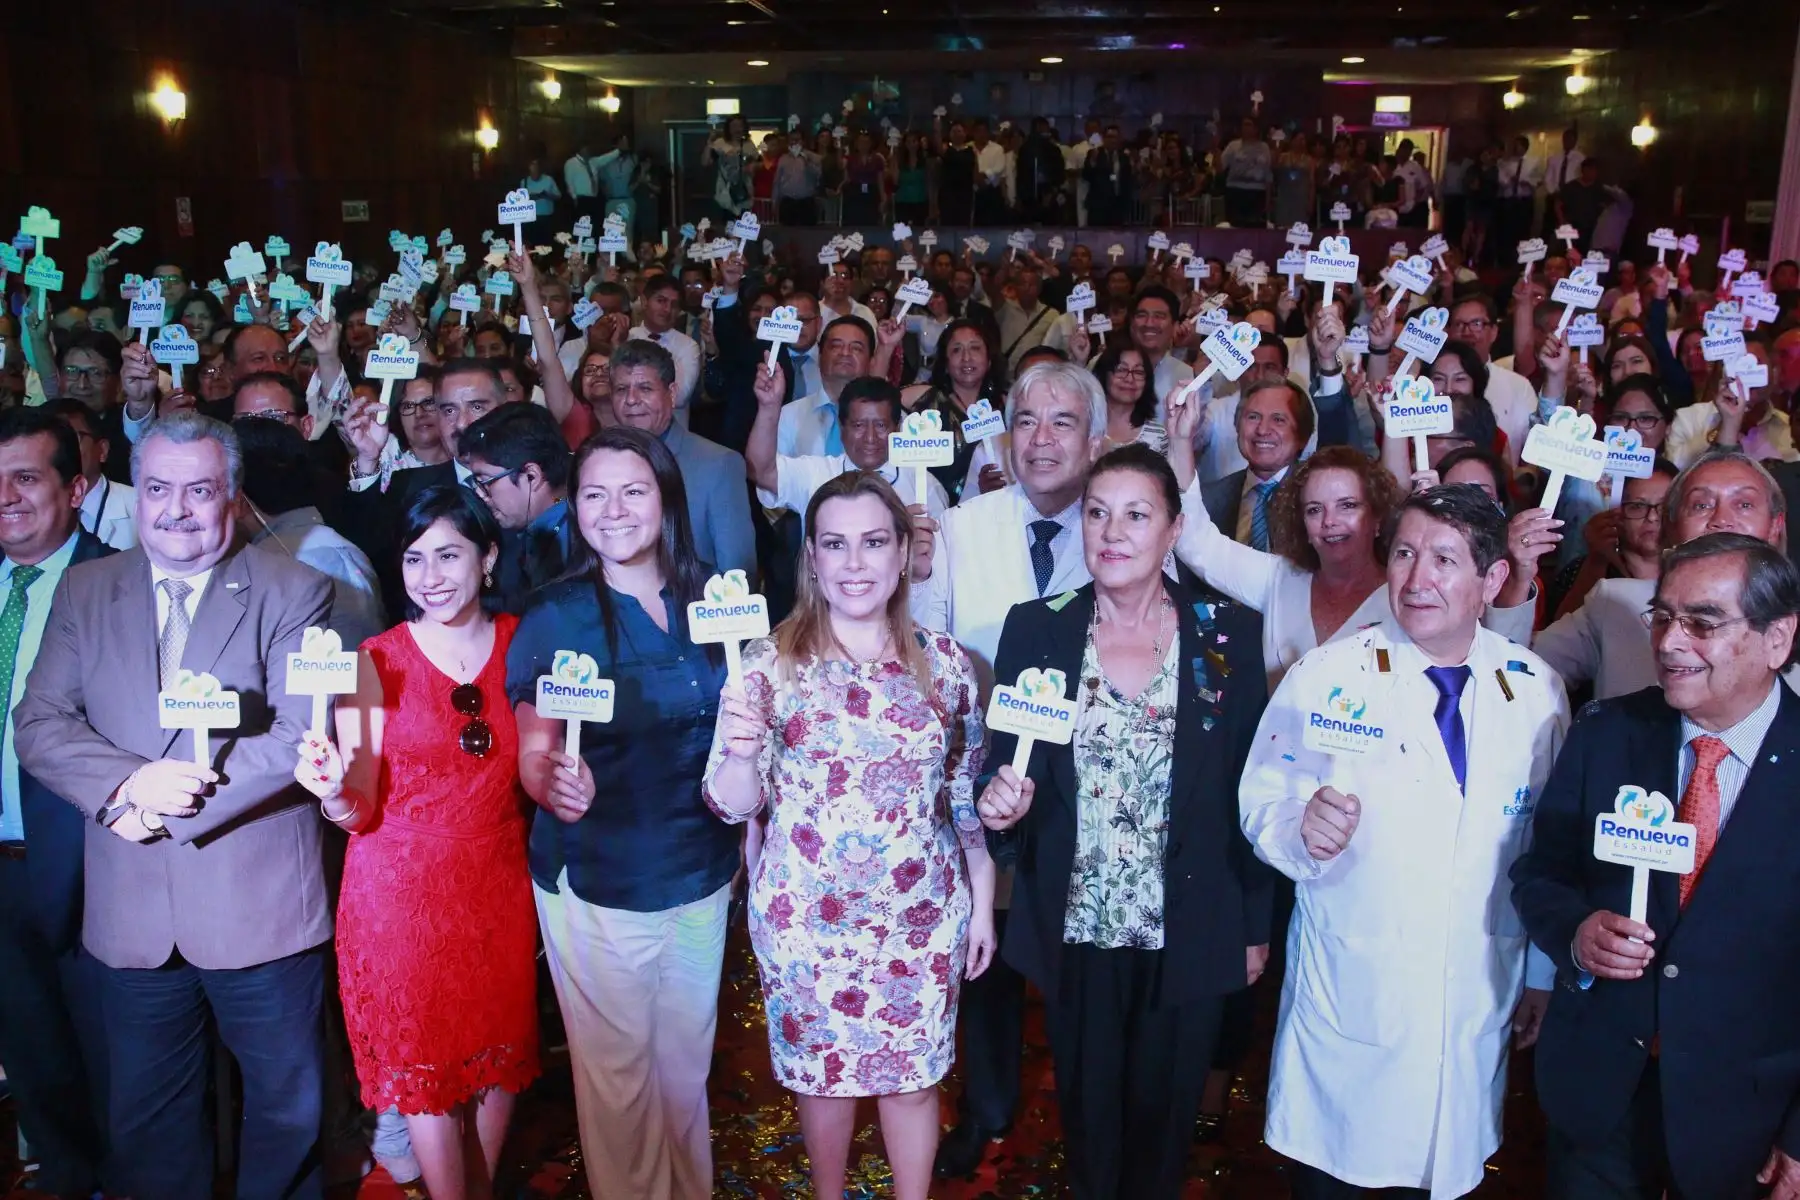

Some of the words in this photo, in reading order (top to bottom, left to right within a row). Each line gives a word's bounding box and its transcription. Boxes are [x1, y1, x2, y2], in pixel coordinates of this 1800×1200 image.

[500, 204, 534, 213] Renueva
[309, 258, 349, 271] Renueva
[1310, 255, 1356, 268] Renueva
[1559, 281, 1599, 296] Renueva
[132, 301, 161, 311] Renueva
[763, 320, 798, 331] Renueva
[1406, 322, 1440, 345] Renueva
[152, 342, 195, 351] Renueva
[1215, 330, 1248, 366] Renueva
[371, 354, 415, 364] Renueva
[1390, 403, 1448, 418] Renueva
[964, 415, 1000, 432] Renueva
[893, 437, 949, 449] Renueva
[1534, 430, 1602, 461] Renueva
[1607, 451, 1650, 463] enueva
[695, 604, 760, 620] Renueva
[293, 658, 352, 671] Renueva
[542, 681, 609, 699] Renueva
[164, 698, 235, 710] Renueva
[998, 692, 1070, 721] Renueva
[1310, 712, 1384, 739] Renueva
[1600, 820, 1689, 847] Renueva
[1614, 840, 1672, 855] EsSalud
